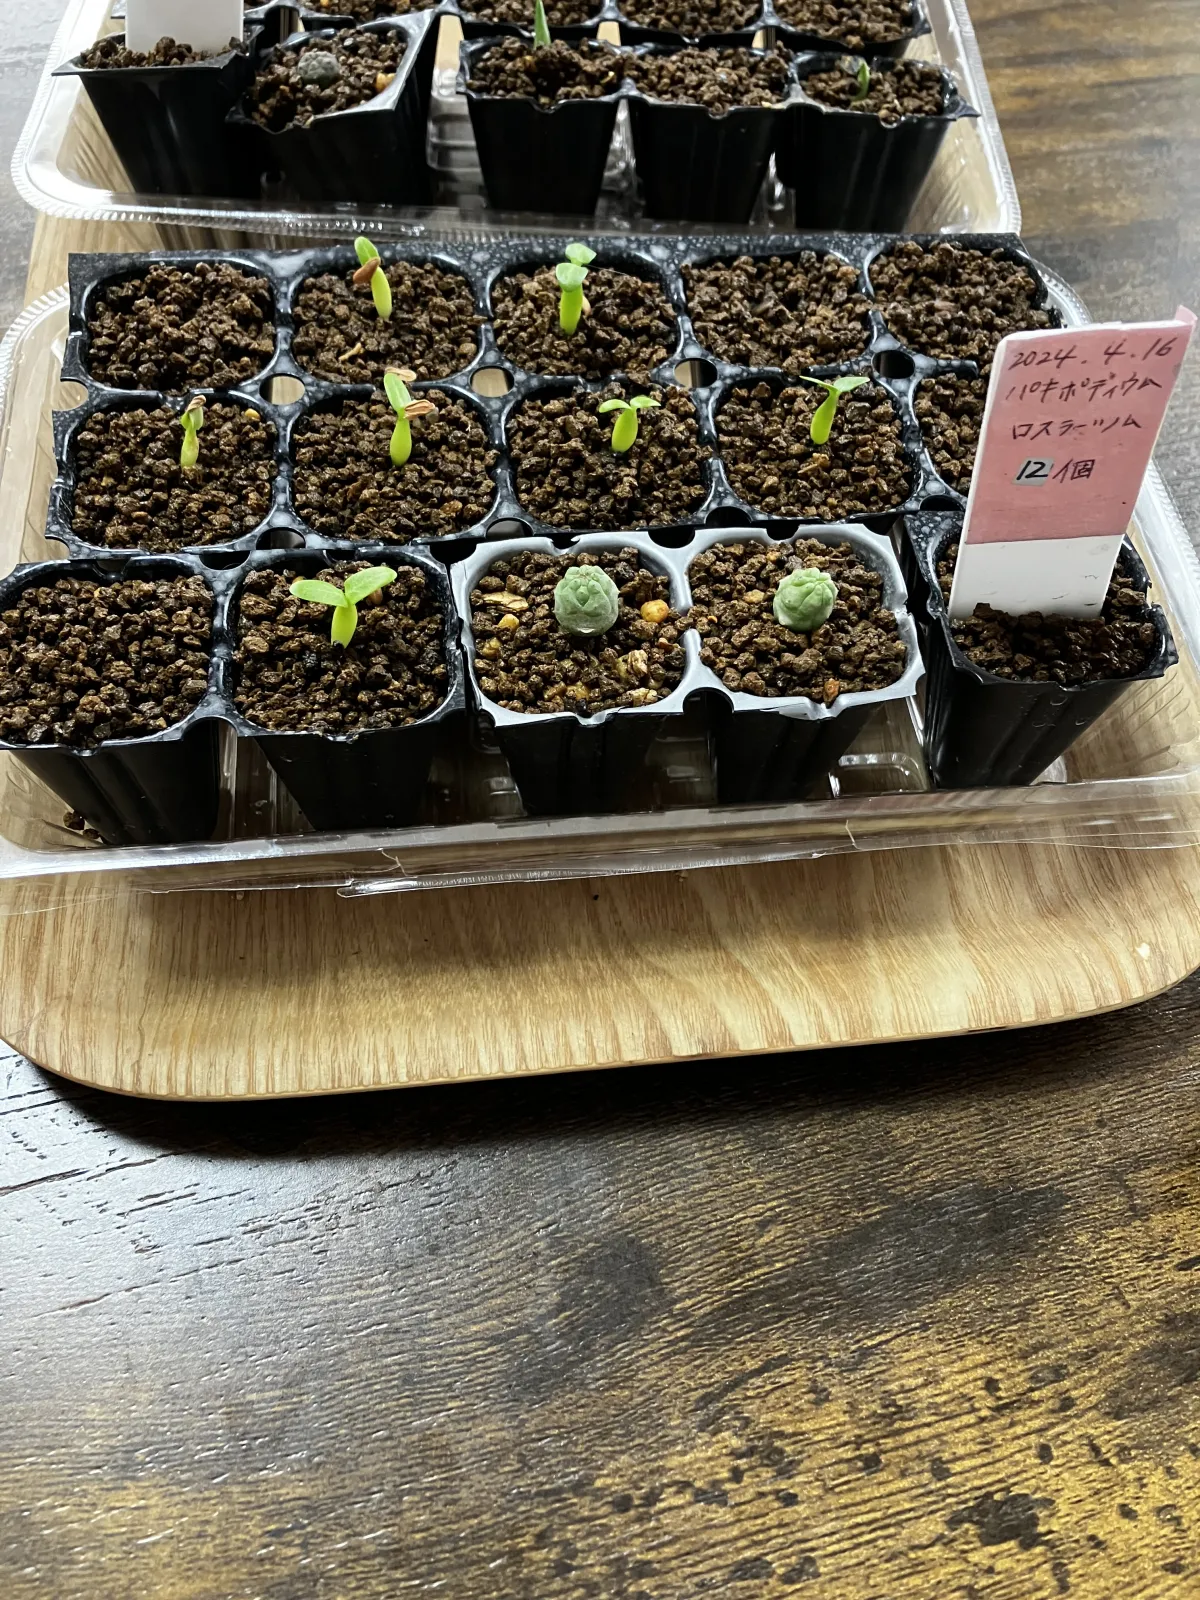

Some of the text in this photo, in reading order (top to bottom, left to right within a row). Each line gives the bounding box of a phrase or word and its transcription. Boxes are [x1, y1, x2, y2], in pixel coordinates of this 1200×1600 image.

[1005, 371, 1162, 403] パキポディウム
